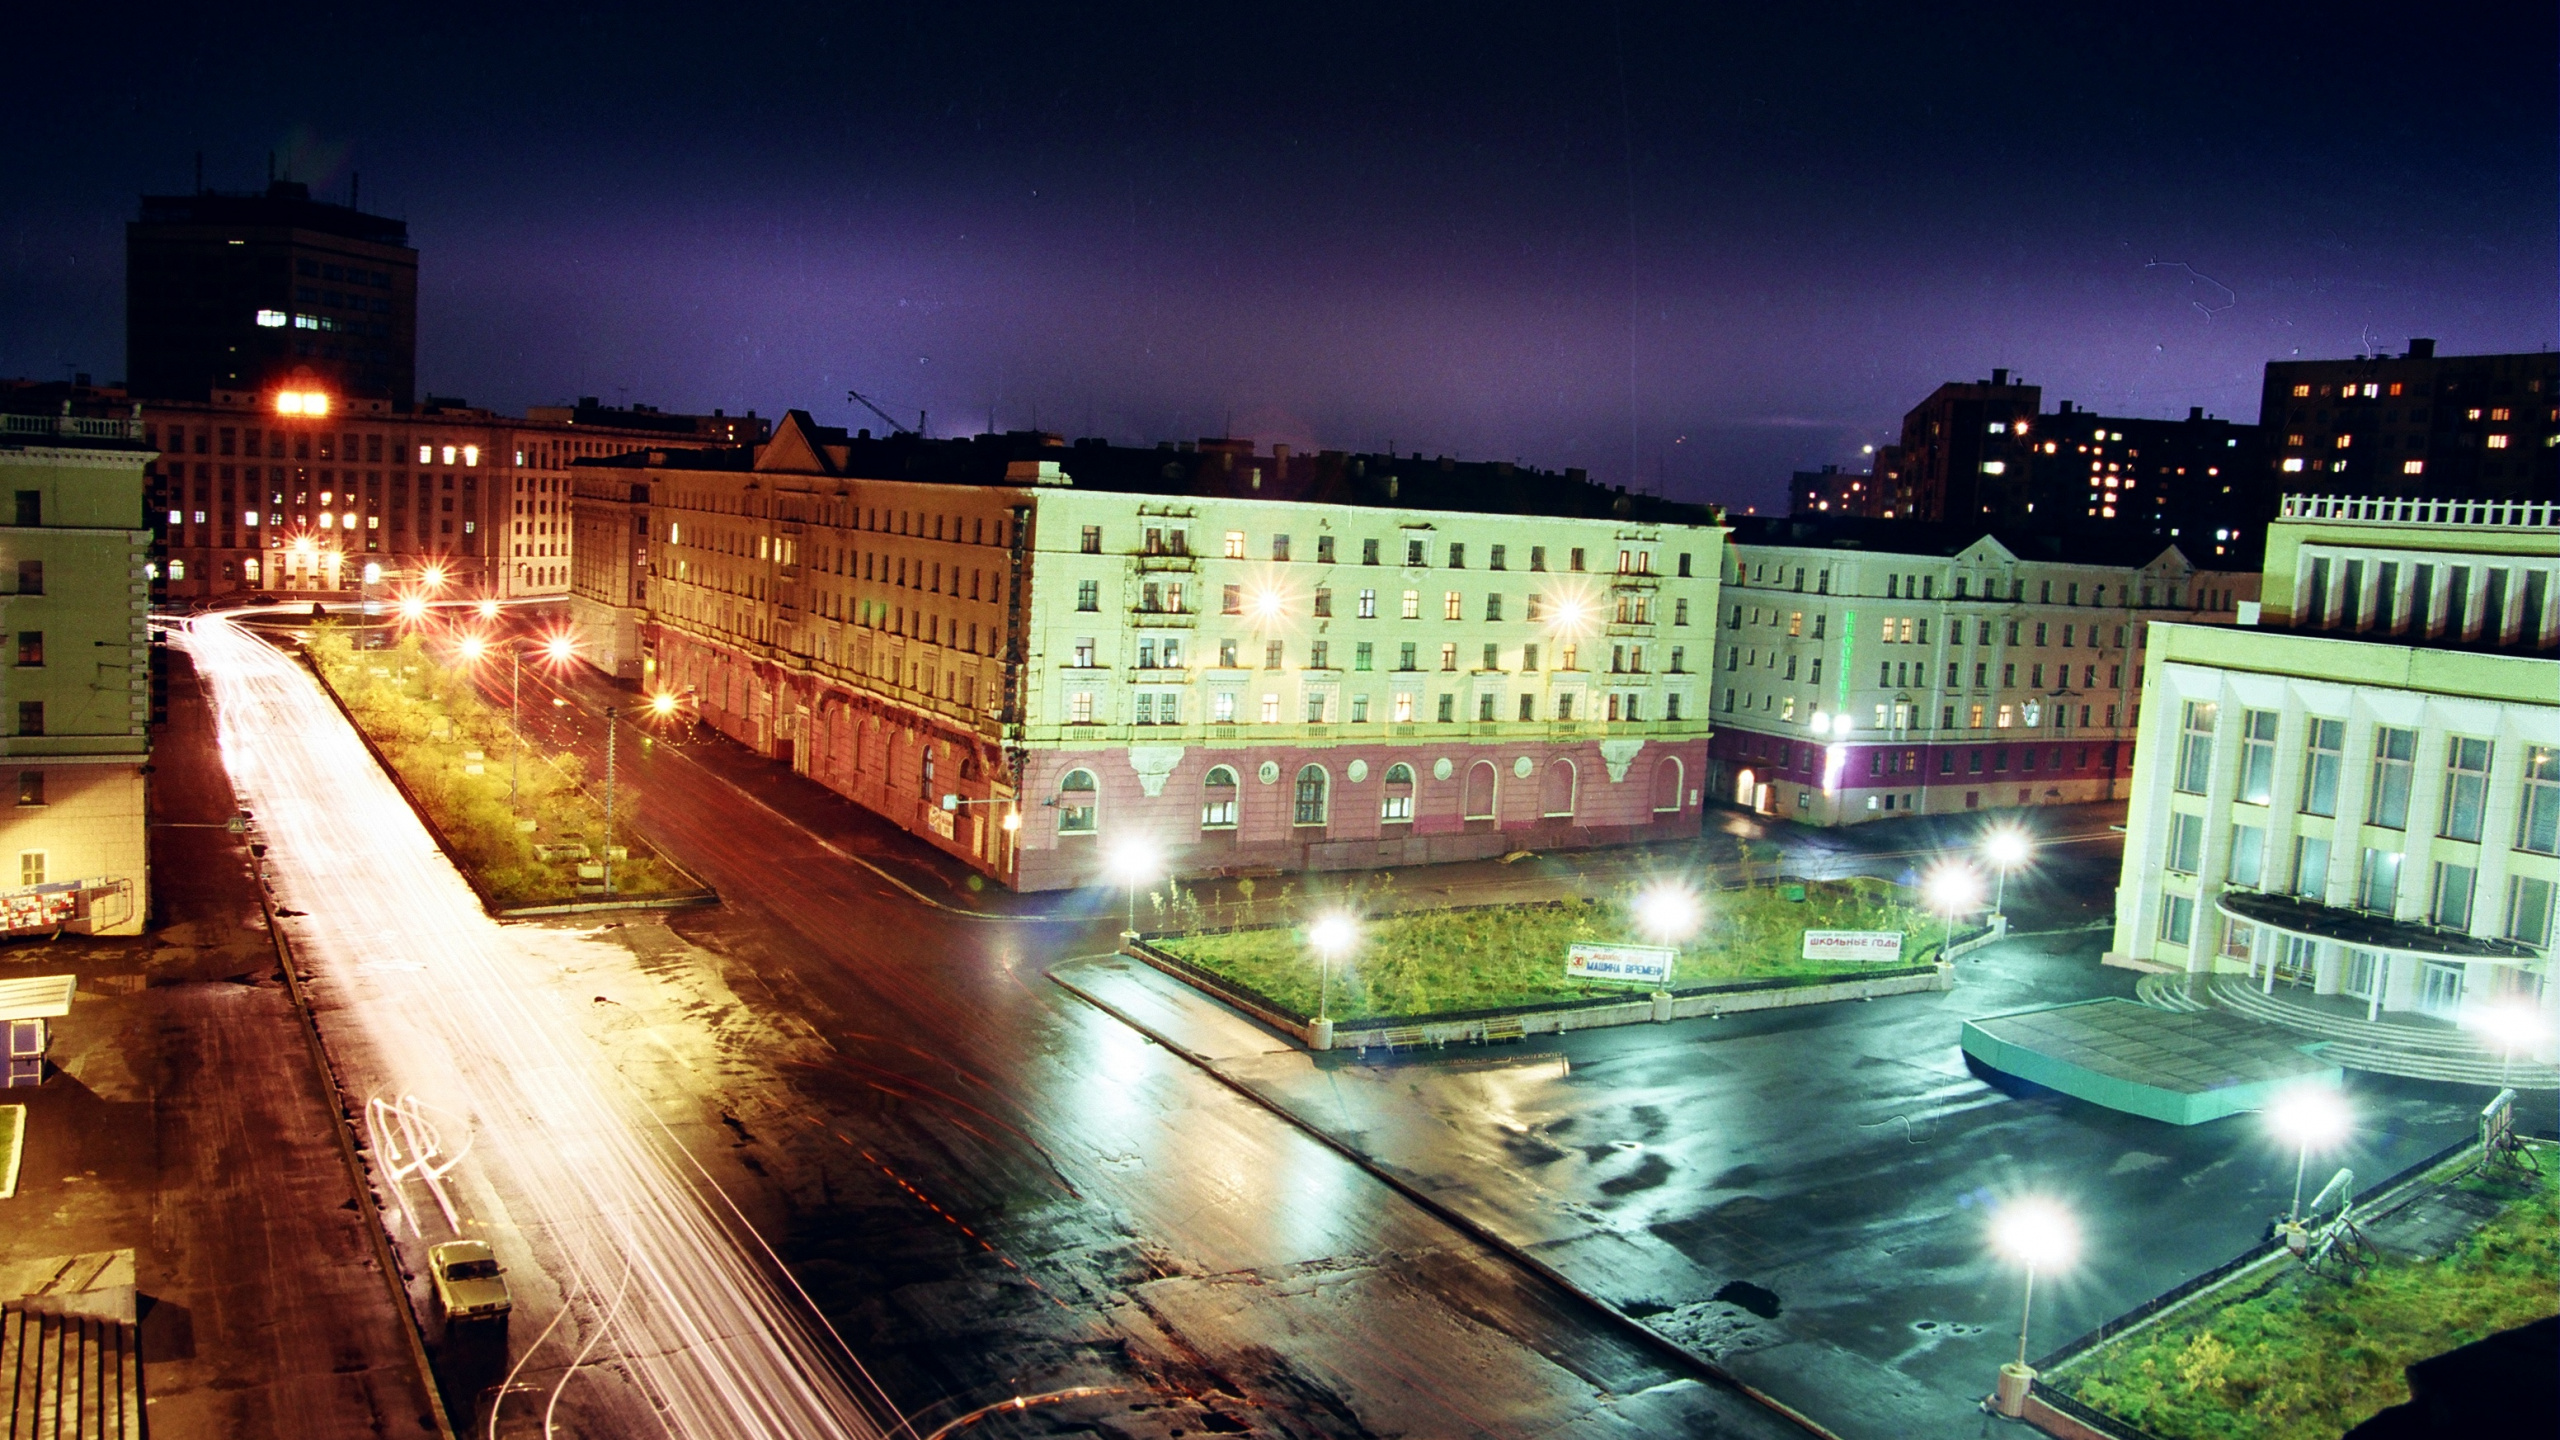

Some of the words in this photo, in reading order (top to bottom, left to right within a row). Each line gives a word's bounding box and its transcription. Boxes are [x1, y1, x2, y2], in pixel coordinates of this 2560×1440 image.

[1810, 938, 1868, 946] ШКОЛЬНЫЕ
[1871, 939, 1898, 948] ГОДЫ
[1586, 961, 1620, 973] МАШИНА
[1625, 964, 1663, 976] ВРЕМЕНИ
